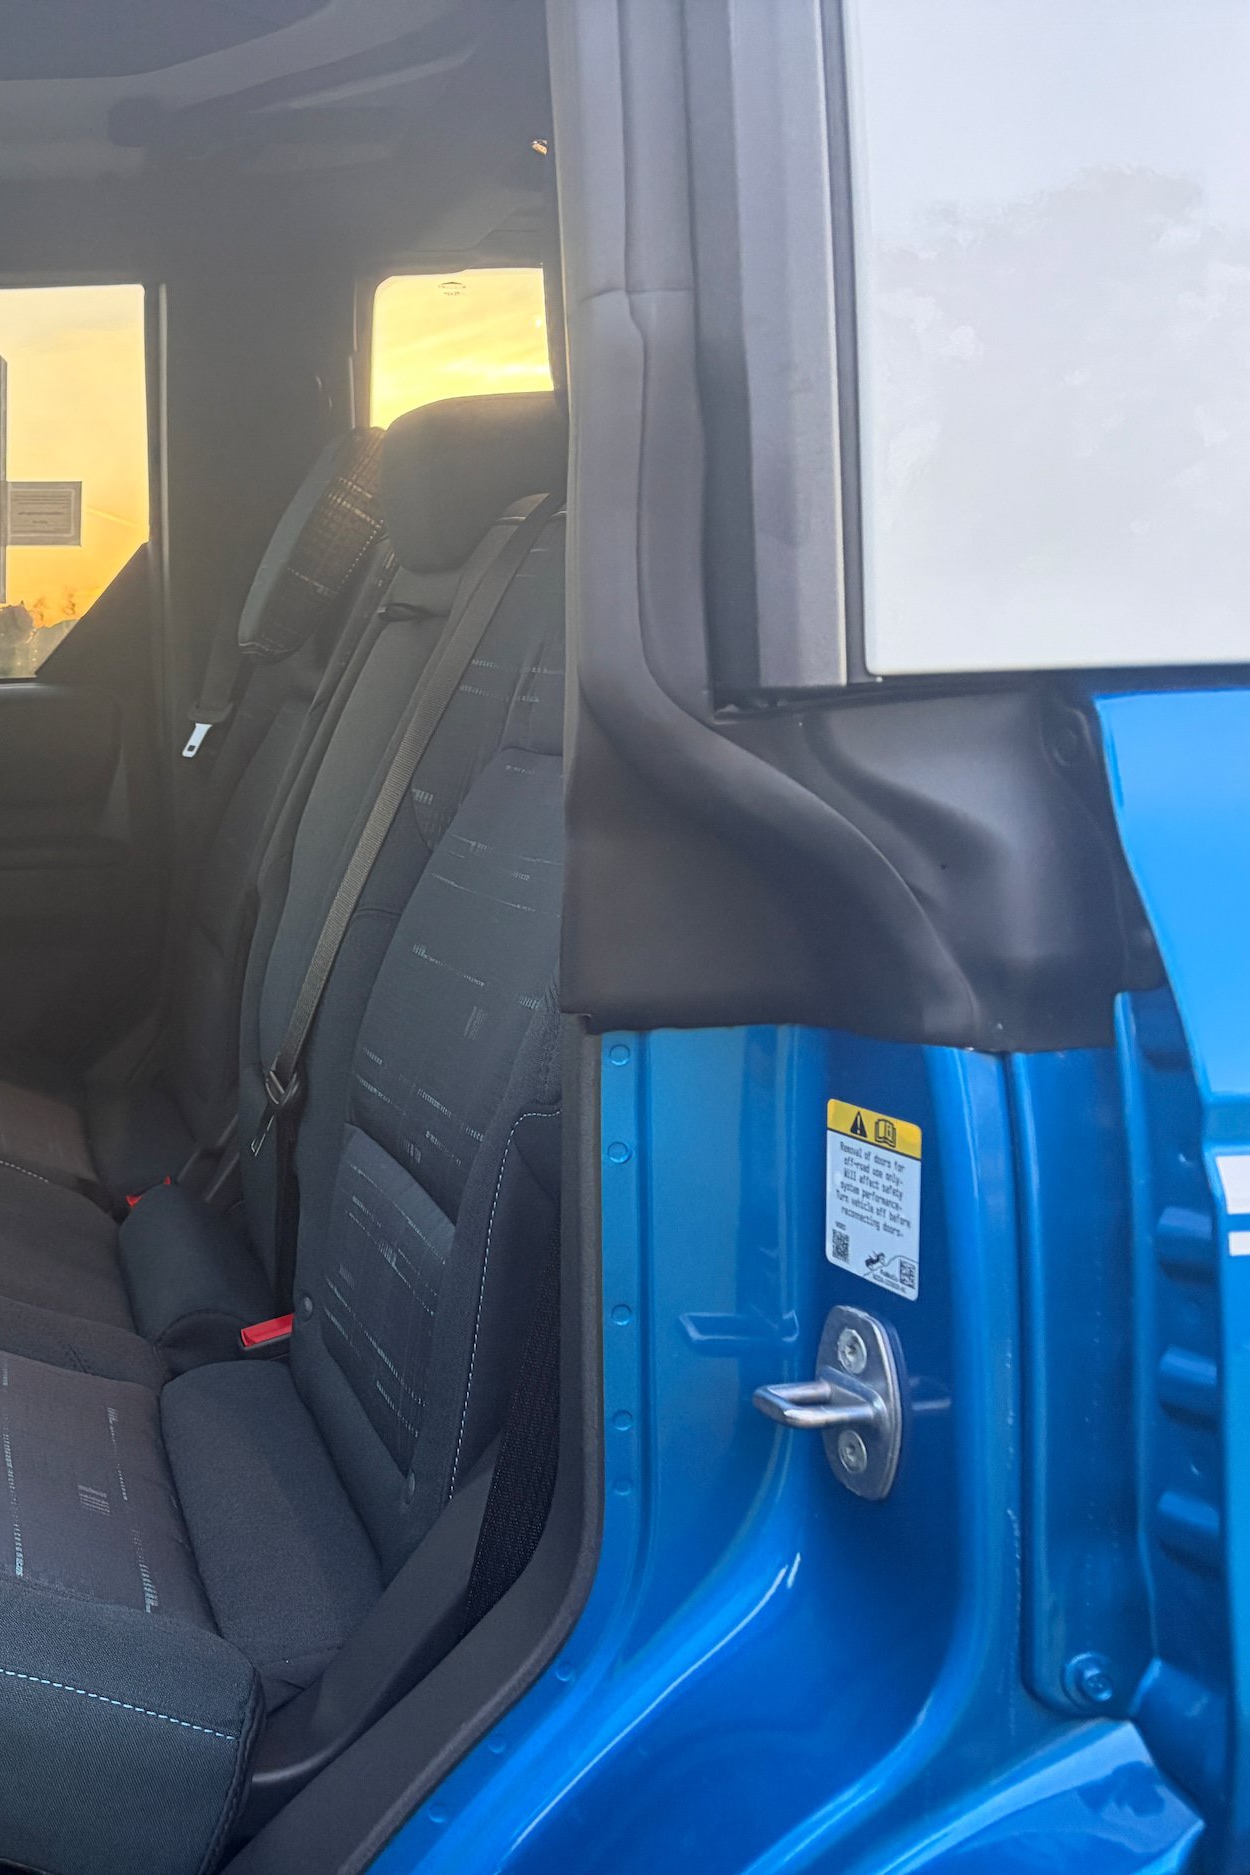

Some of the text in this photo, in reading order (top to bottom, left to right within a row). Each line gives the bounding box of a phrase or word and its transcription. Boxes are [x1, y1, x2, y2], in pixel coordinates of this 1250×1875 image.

[840, 1141, 905, 1172] Removal of doors for
[844, 1156, 870, 1173] off-road
[872, 1168, 883, 1178] use
[840, 1181, 860, 1195] system
[844, 1168, 903, 1201] Will affect safety
[836, 1189, 911, 1228] Turn vehicle off before
[841, 1206, 880, 1231] reconnecting
